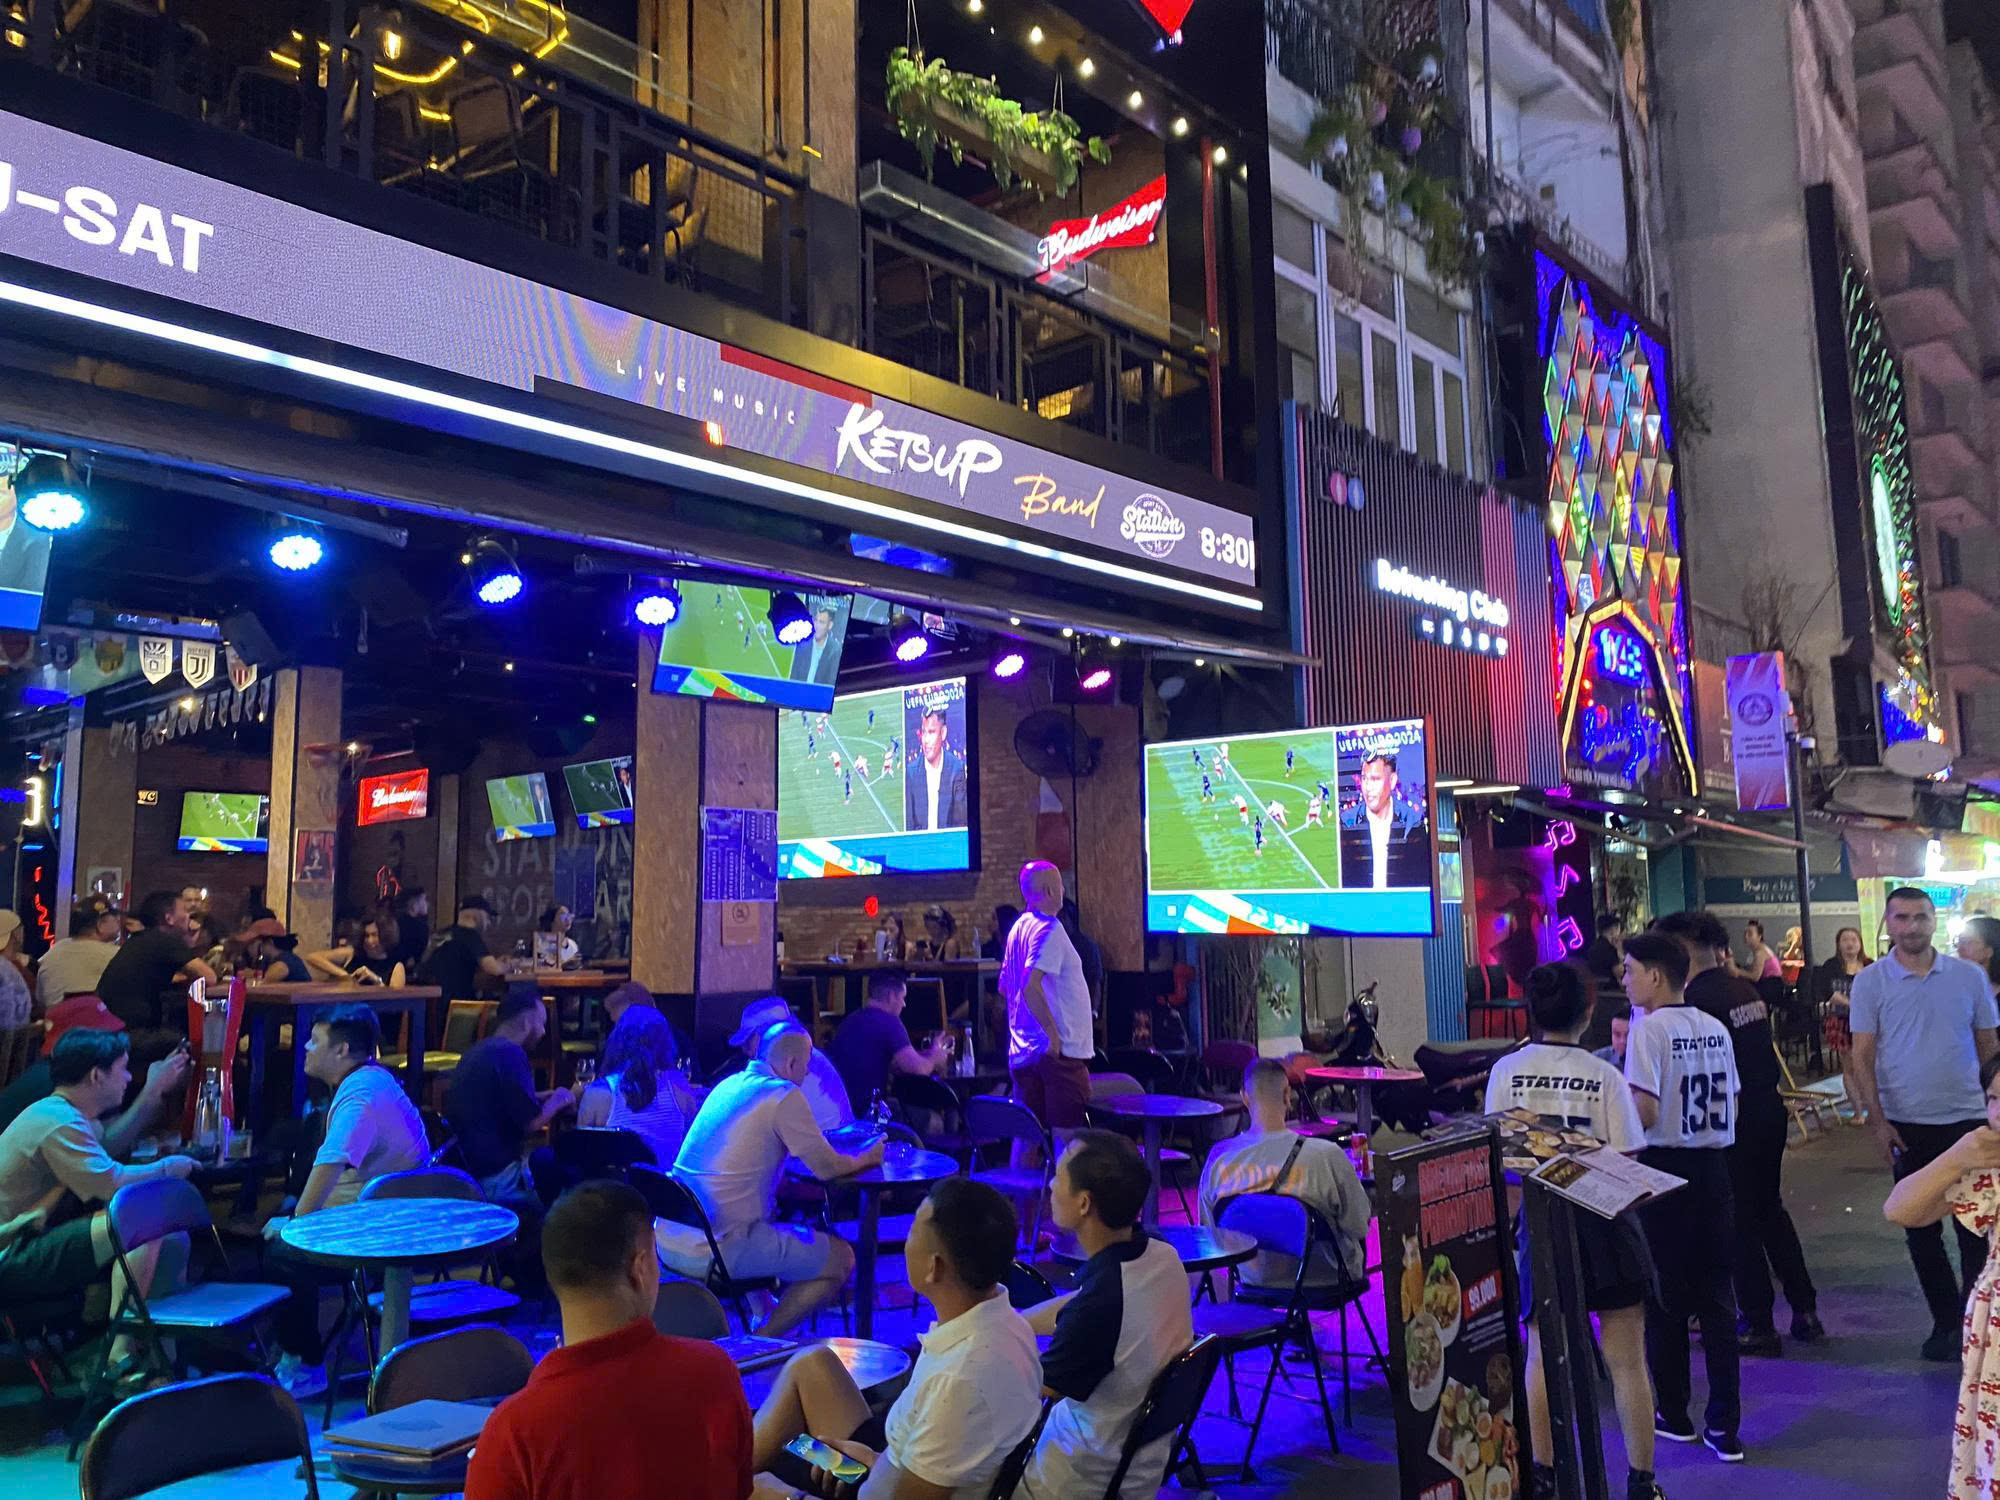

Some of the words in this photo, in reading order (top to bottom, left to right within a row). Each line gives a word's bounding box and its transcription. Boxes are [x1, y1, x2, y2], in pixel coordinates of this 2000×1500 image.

[0, 161, 214, 273] -SAT
[1037, 198, 1162, 267] Budweiser
[616, 359, 686, 393] LIVE
[713, 388, 796, 425] MUSIC
[834, 402, 1003, 500] KETSUP
[1013, 472, 1106, 529] Band
[1338, 737, 1363, 753] UEFA
[138, 790, 156, 801] WC
[1672, 1035, 1725, 1052] STATION
[1512, 1075, 1602, 1093] STATION
[1680, 1072, 1729, 1135] 135
